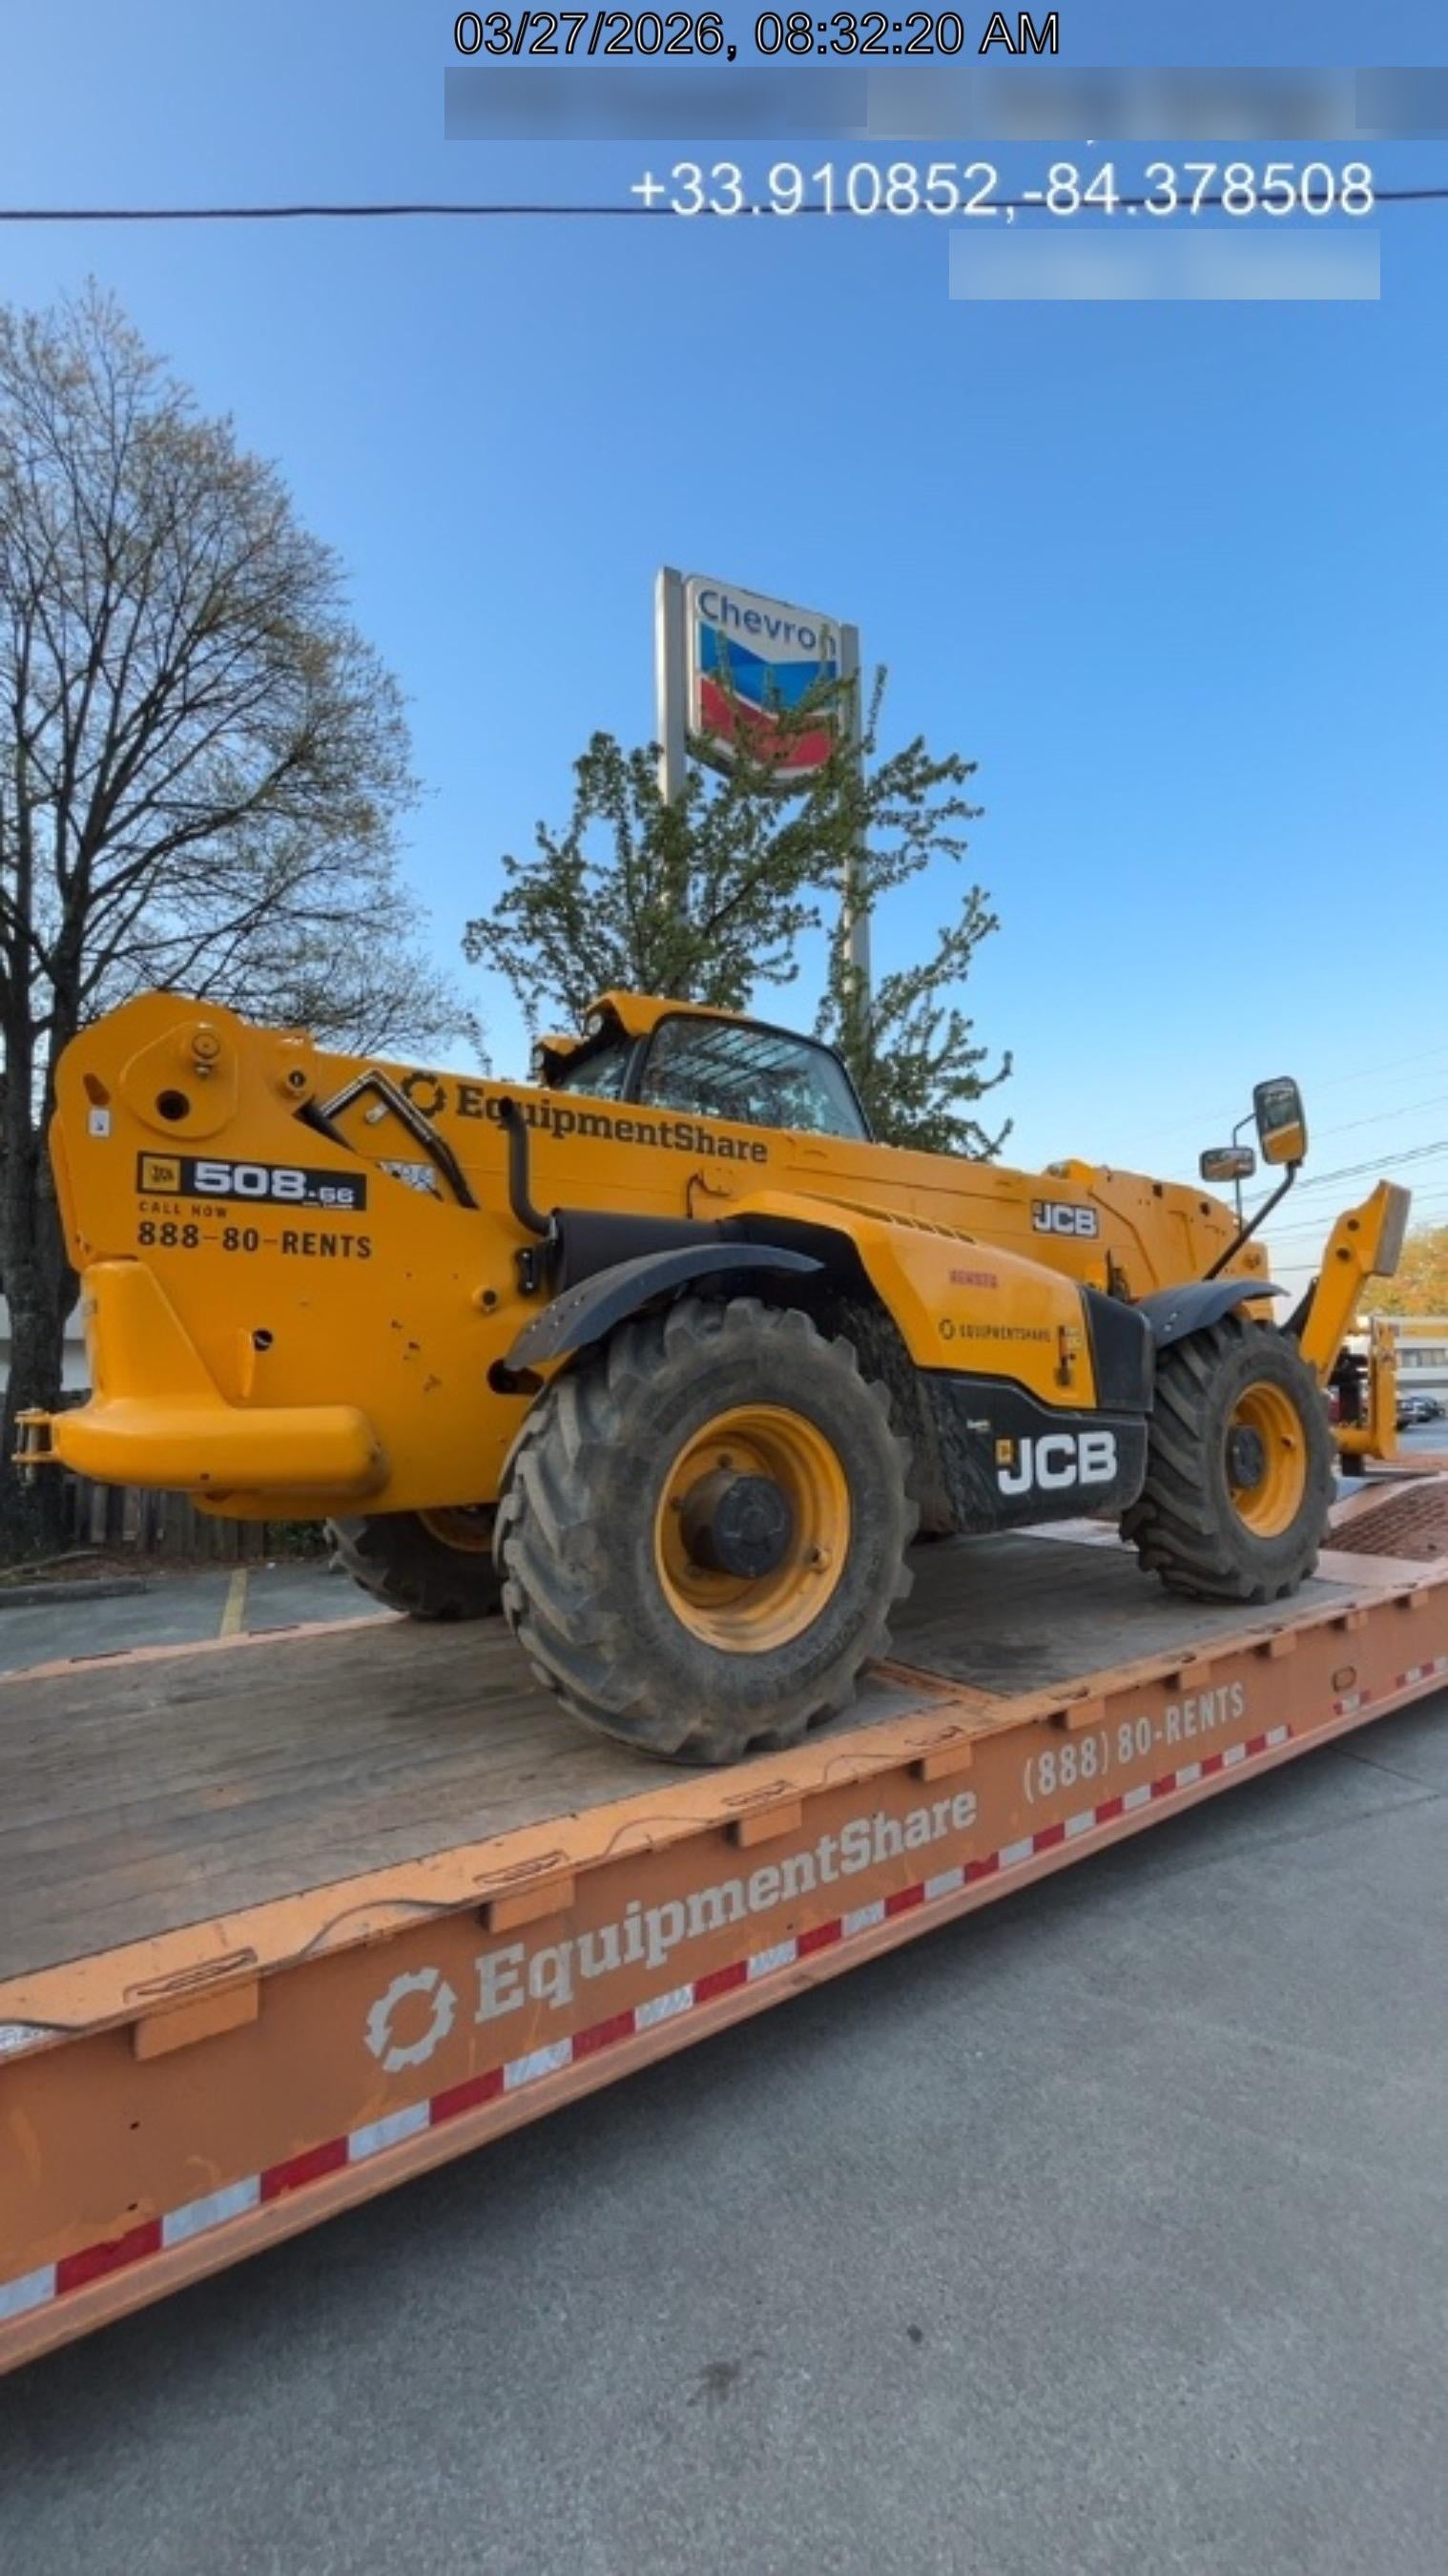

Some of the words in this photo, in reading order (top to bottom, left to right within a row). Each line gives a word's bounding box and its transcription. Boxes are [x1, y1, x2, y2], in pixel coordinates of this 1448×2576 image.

[138, 1200, 182, 1215] CALL
[191, 1204, 228, 1218] NOW
[1033, 1201, 1097, 1236] JCB
[997, 1430, 1118, 1495] JCB
[1024, 1730, 1110, 1805] (888)
[1117, 1681, 1245, 1765] 80-RENTS
[474, 1790, 979, 2024] EquipmentShare
